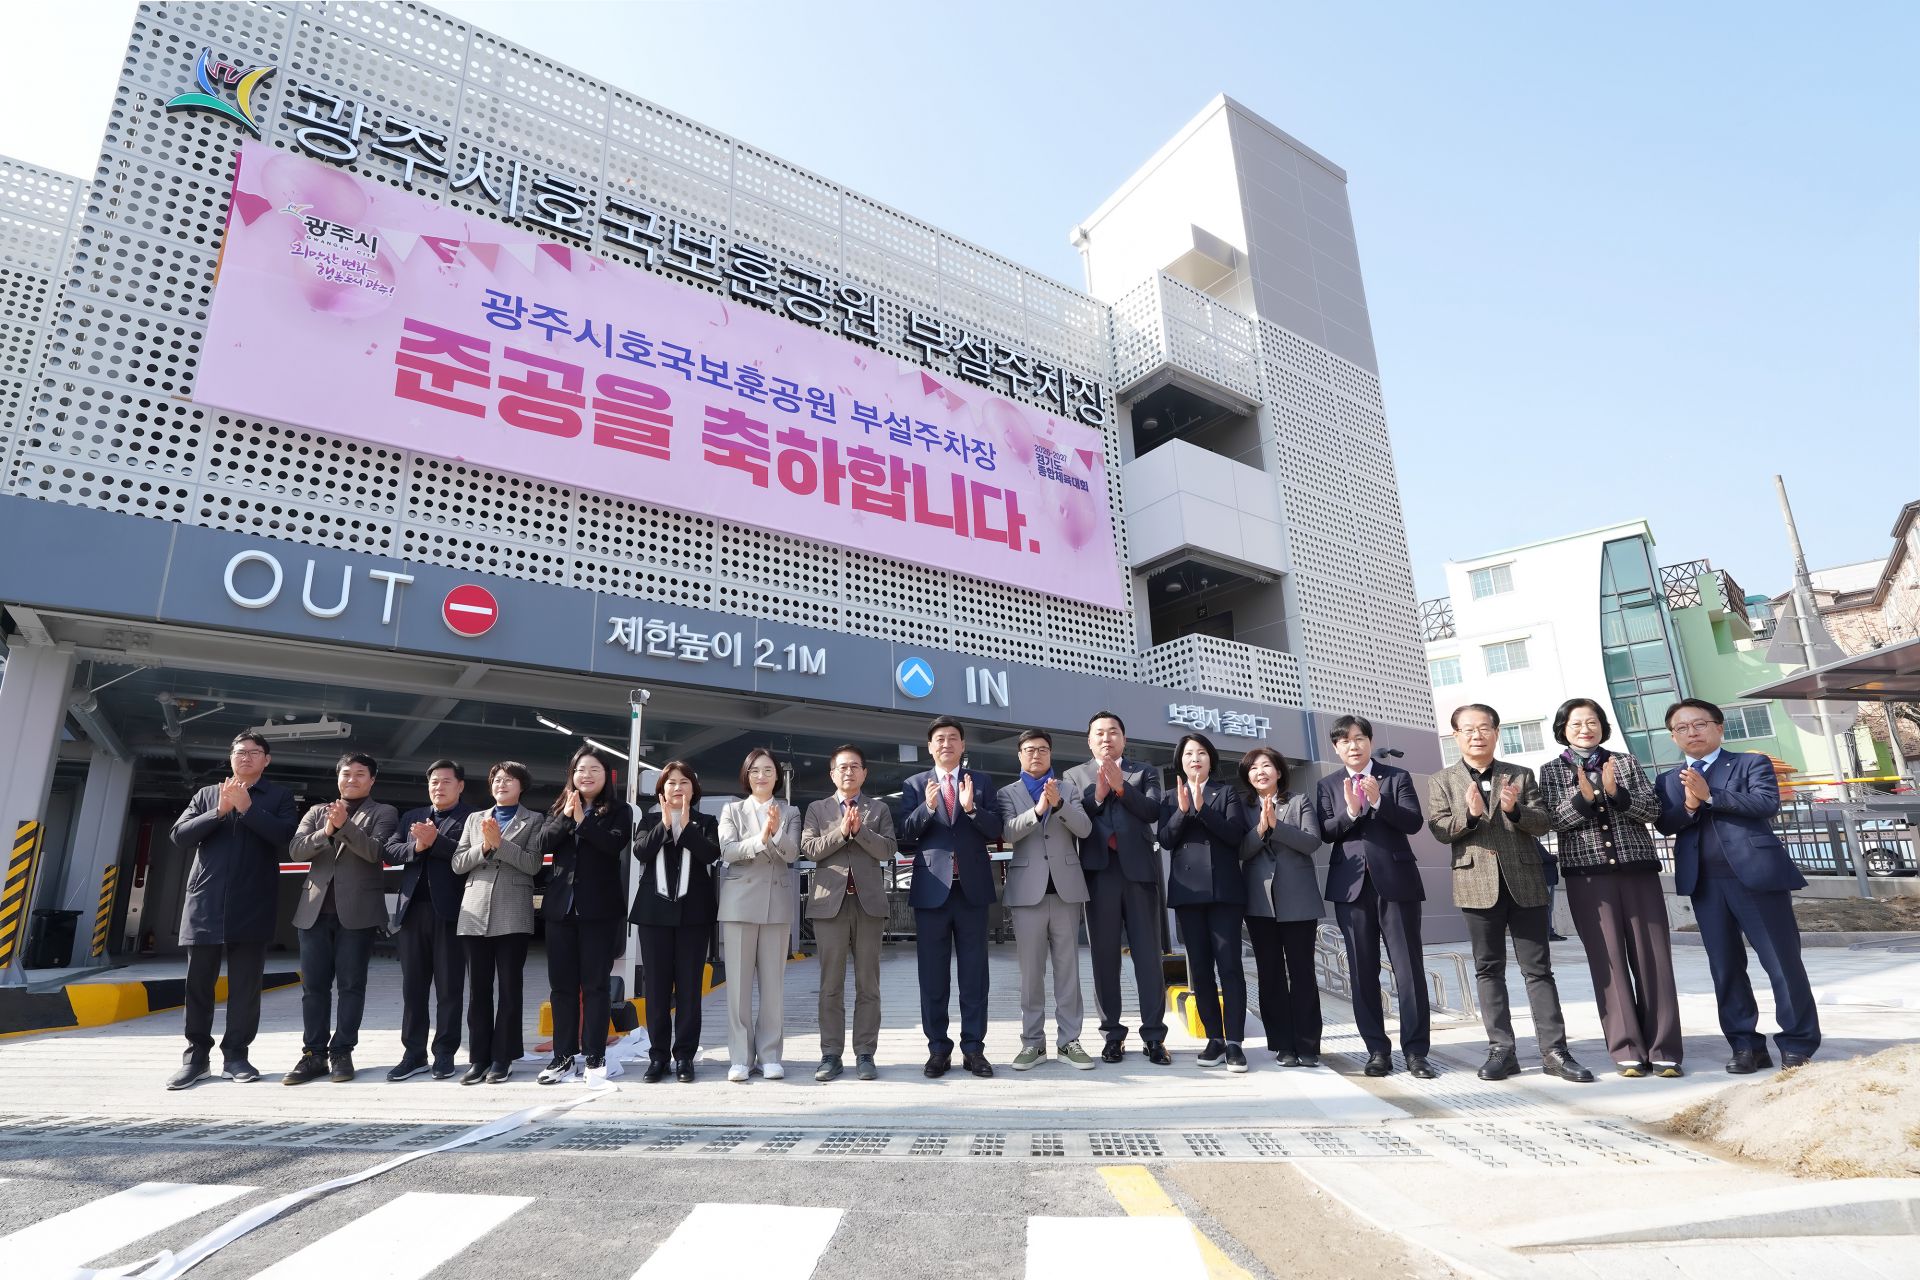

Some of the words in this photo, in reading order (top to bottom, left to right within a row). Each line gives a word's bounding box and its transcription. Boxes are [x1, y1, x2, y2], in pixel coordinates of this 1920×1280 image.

[304, 216, 377, 253] 광주시
[306, 235, 350, 252] GWANGJU
[356, 250, 376, 259] CITY
[287, 83, 880, 345] 광주시호국보훈공원
[905, 310, 1107, 426] 부설주차장
[316, 262, 363, 286] 행복도시
[365, 280, 394, 296] 광주!
[481, 288, 836, 423] 광주시호국보훈공원
[850, 400, 997, 472] 부설주차장
[394, 316, 674, 461] 준공을
[701, 405, 1041, 554] 축하합니다.
[1036, 453, 1063, 471] 경기도
[1038, 465, 1089, 492] 종합체육대회
[224, 550, 414, 624] OUT
[605, 616, 742, 668] 제한높이
[753, 638, 826, 675] 2.1M
[965, 666, 1009, 707] IN
[1168, 703, 1221, 733] 보행자
[1222, 711, 1272, 739] 출입구
